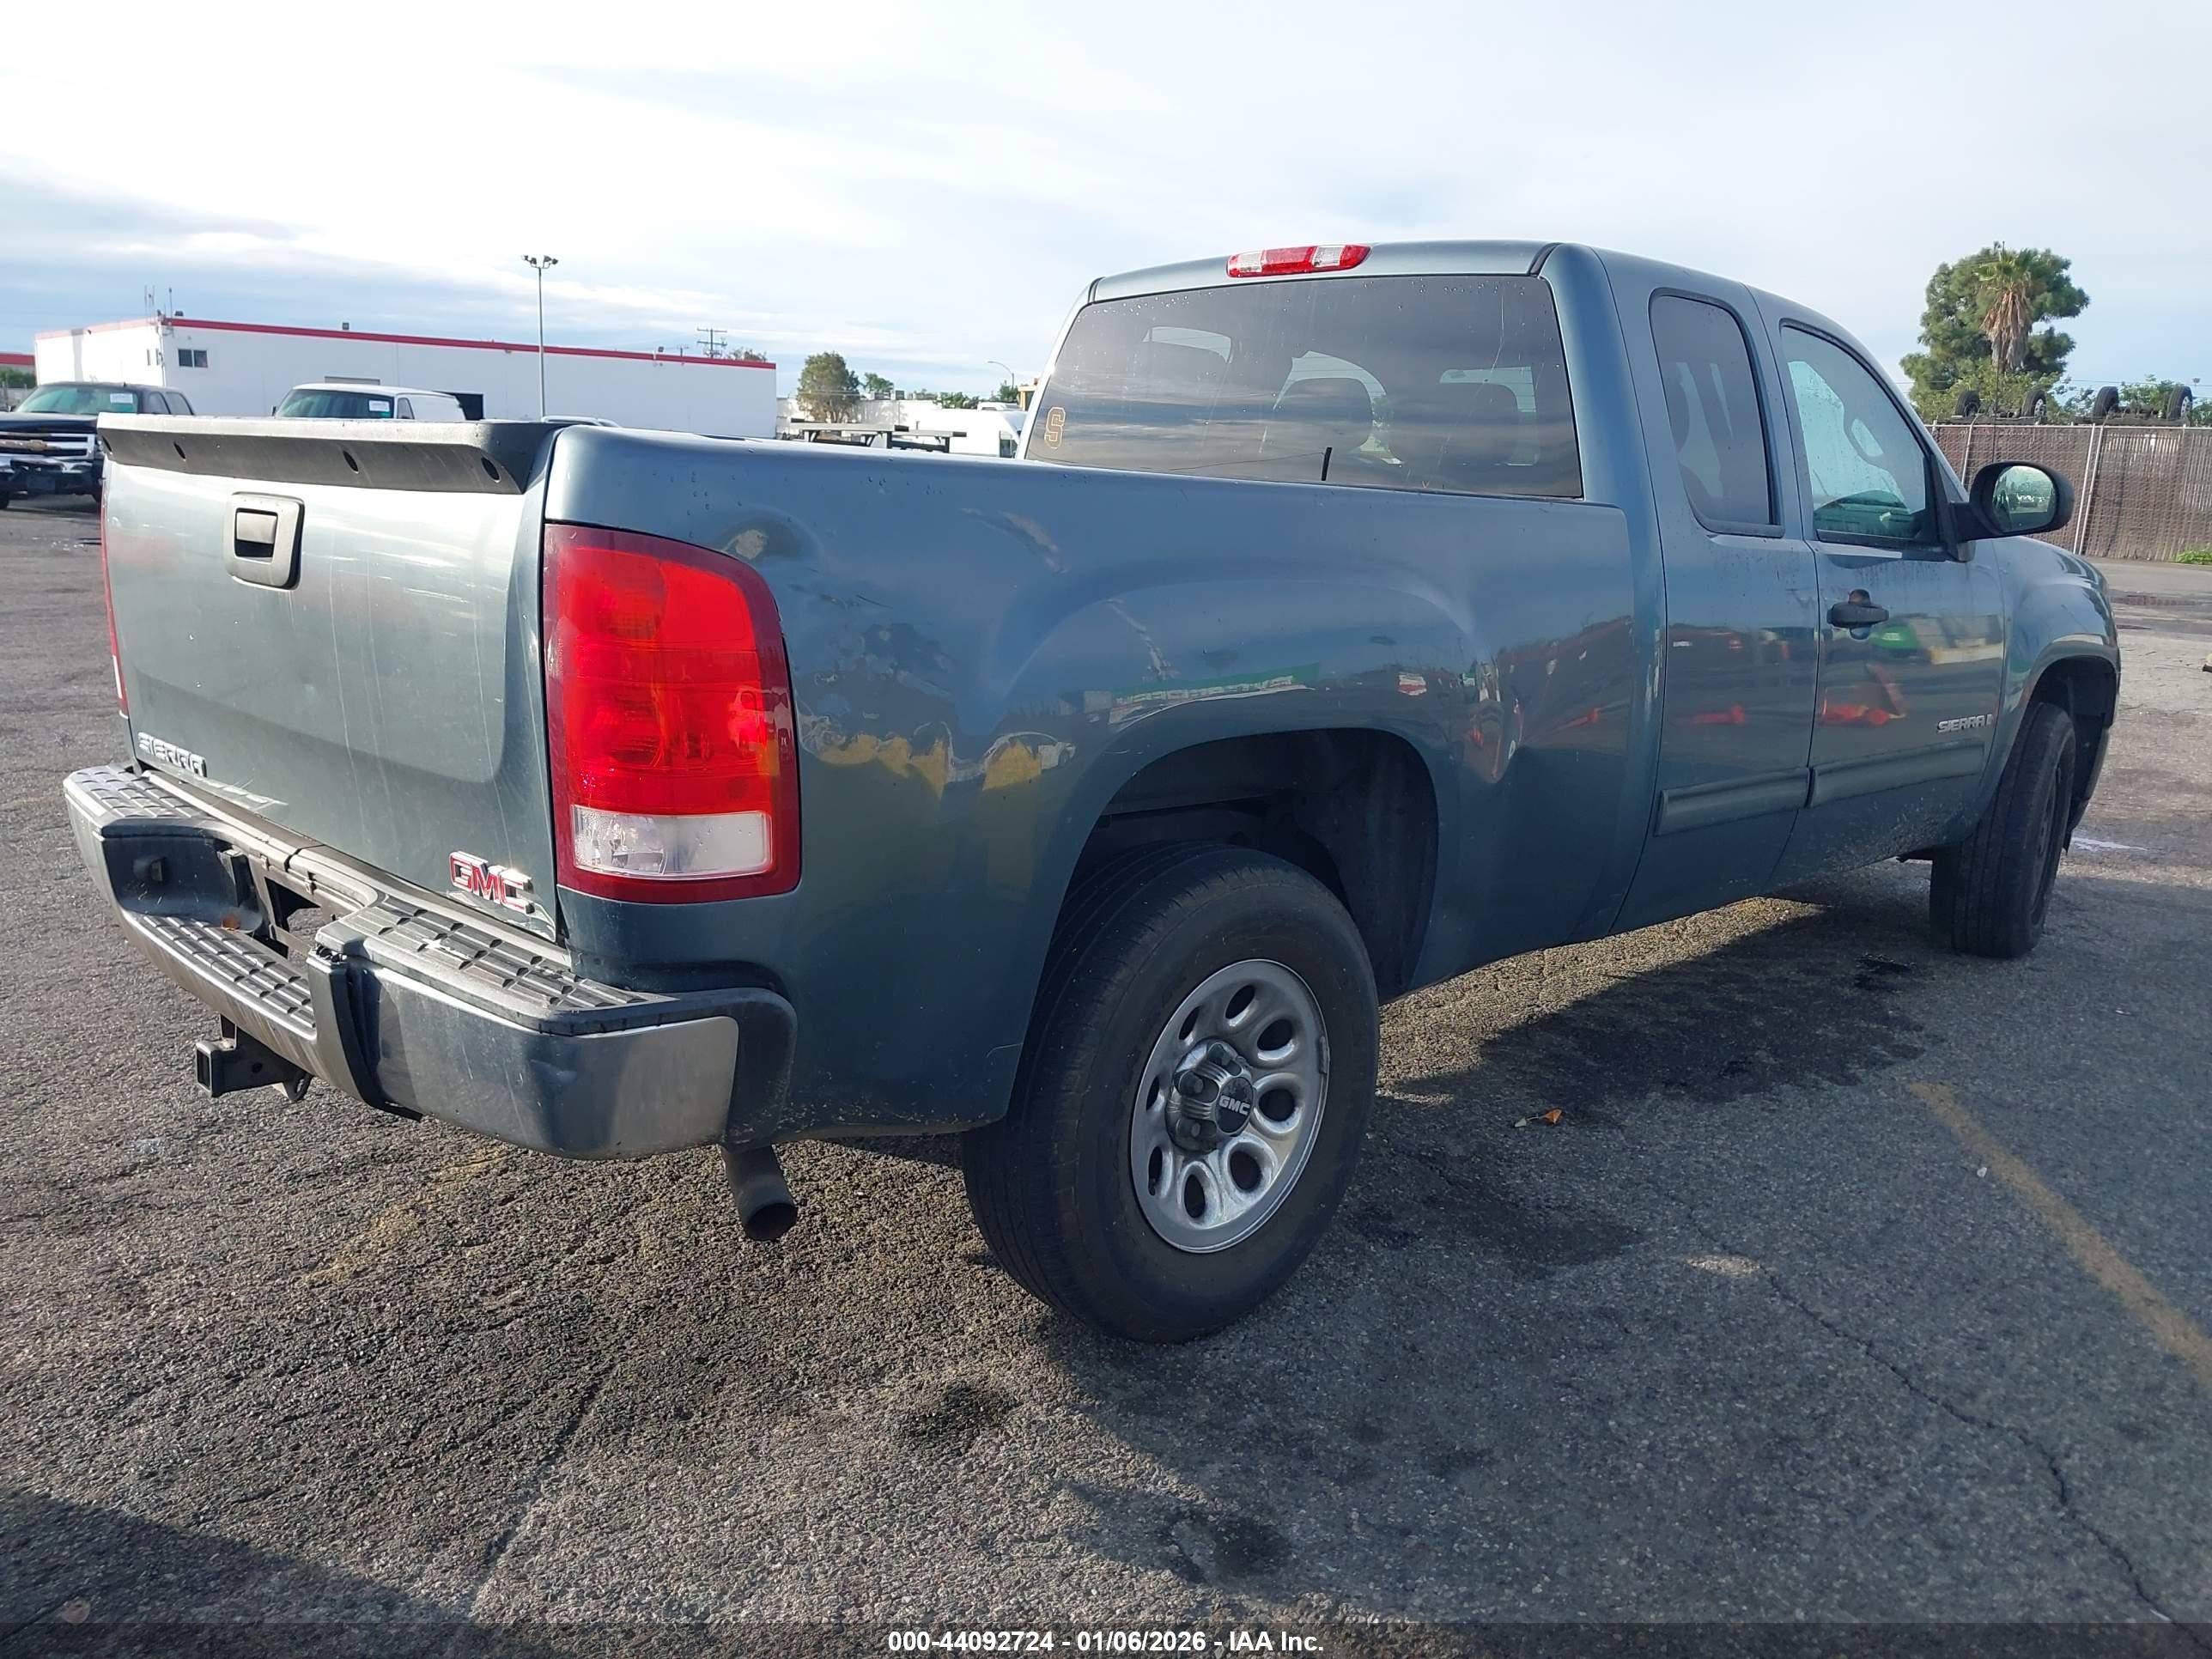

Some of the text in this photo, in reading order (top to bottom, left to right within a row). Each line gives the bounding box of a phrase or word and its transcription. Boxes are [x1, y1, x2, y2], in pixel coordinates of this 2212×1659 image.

[1937, 716, 1985, 733] SIERRA
[137, 732, 207, 777] SIERRA
[449, 851, 535, 915] GMC
[1219, 1095, 1251, 1116] GMC
